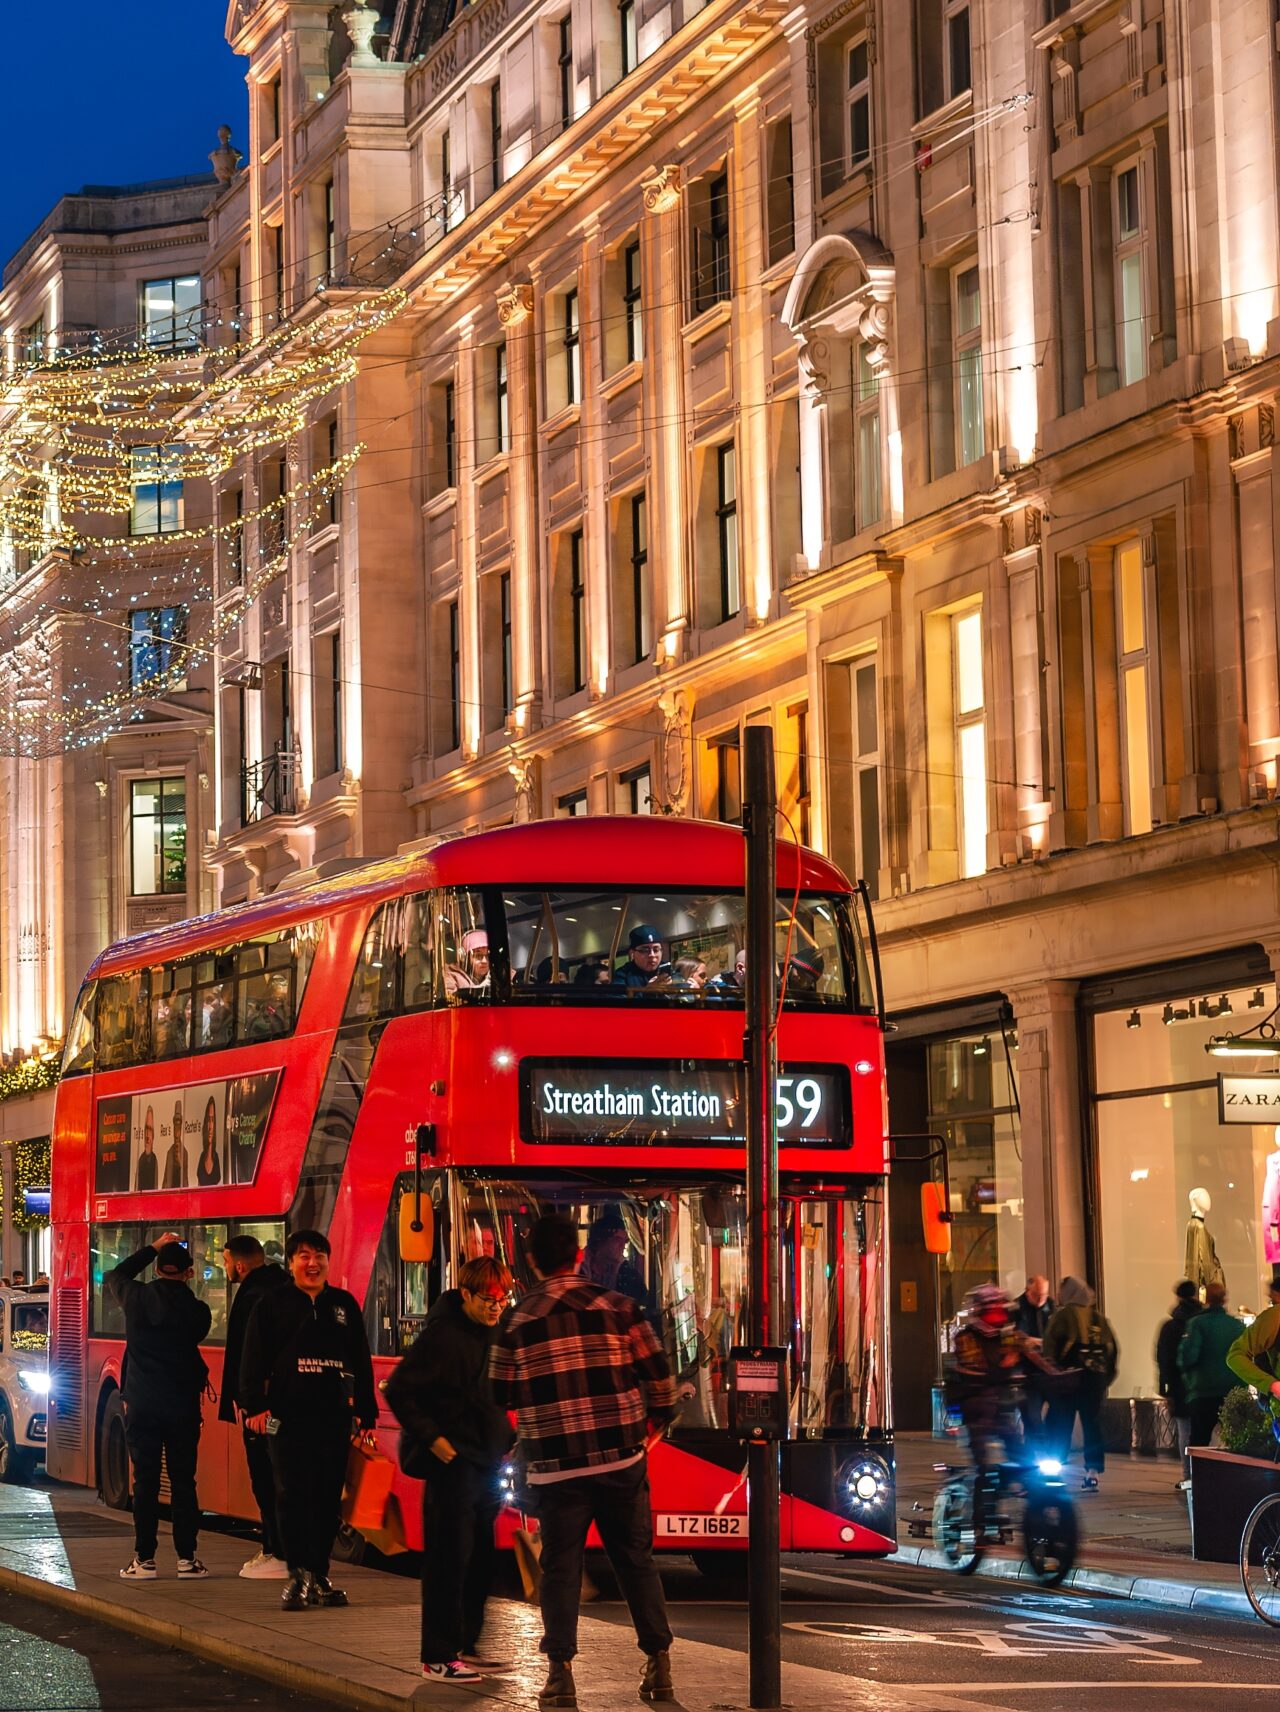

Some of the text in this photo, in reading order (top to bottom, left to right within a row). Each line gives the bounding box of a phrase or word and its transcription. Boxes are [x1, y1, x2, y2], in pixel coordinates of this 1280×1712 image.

[543, 1082, 644, 1116] Streatham
[650, 1084, 720, 1118] Station
[1226, 1093, 1280, 1106] ZARA
[239, 1113, 257, 1127] Cancer
[238, 1131, 256, 1149] Charity
[297, 1365, 323, 1373] CLUB
[667, 1516, 740, 1535] LTZ 1682
